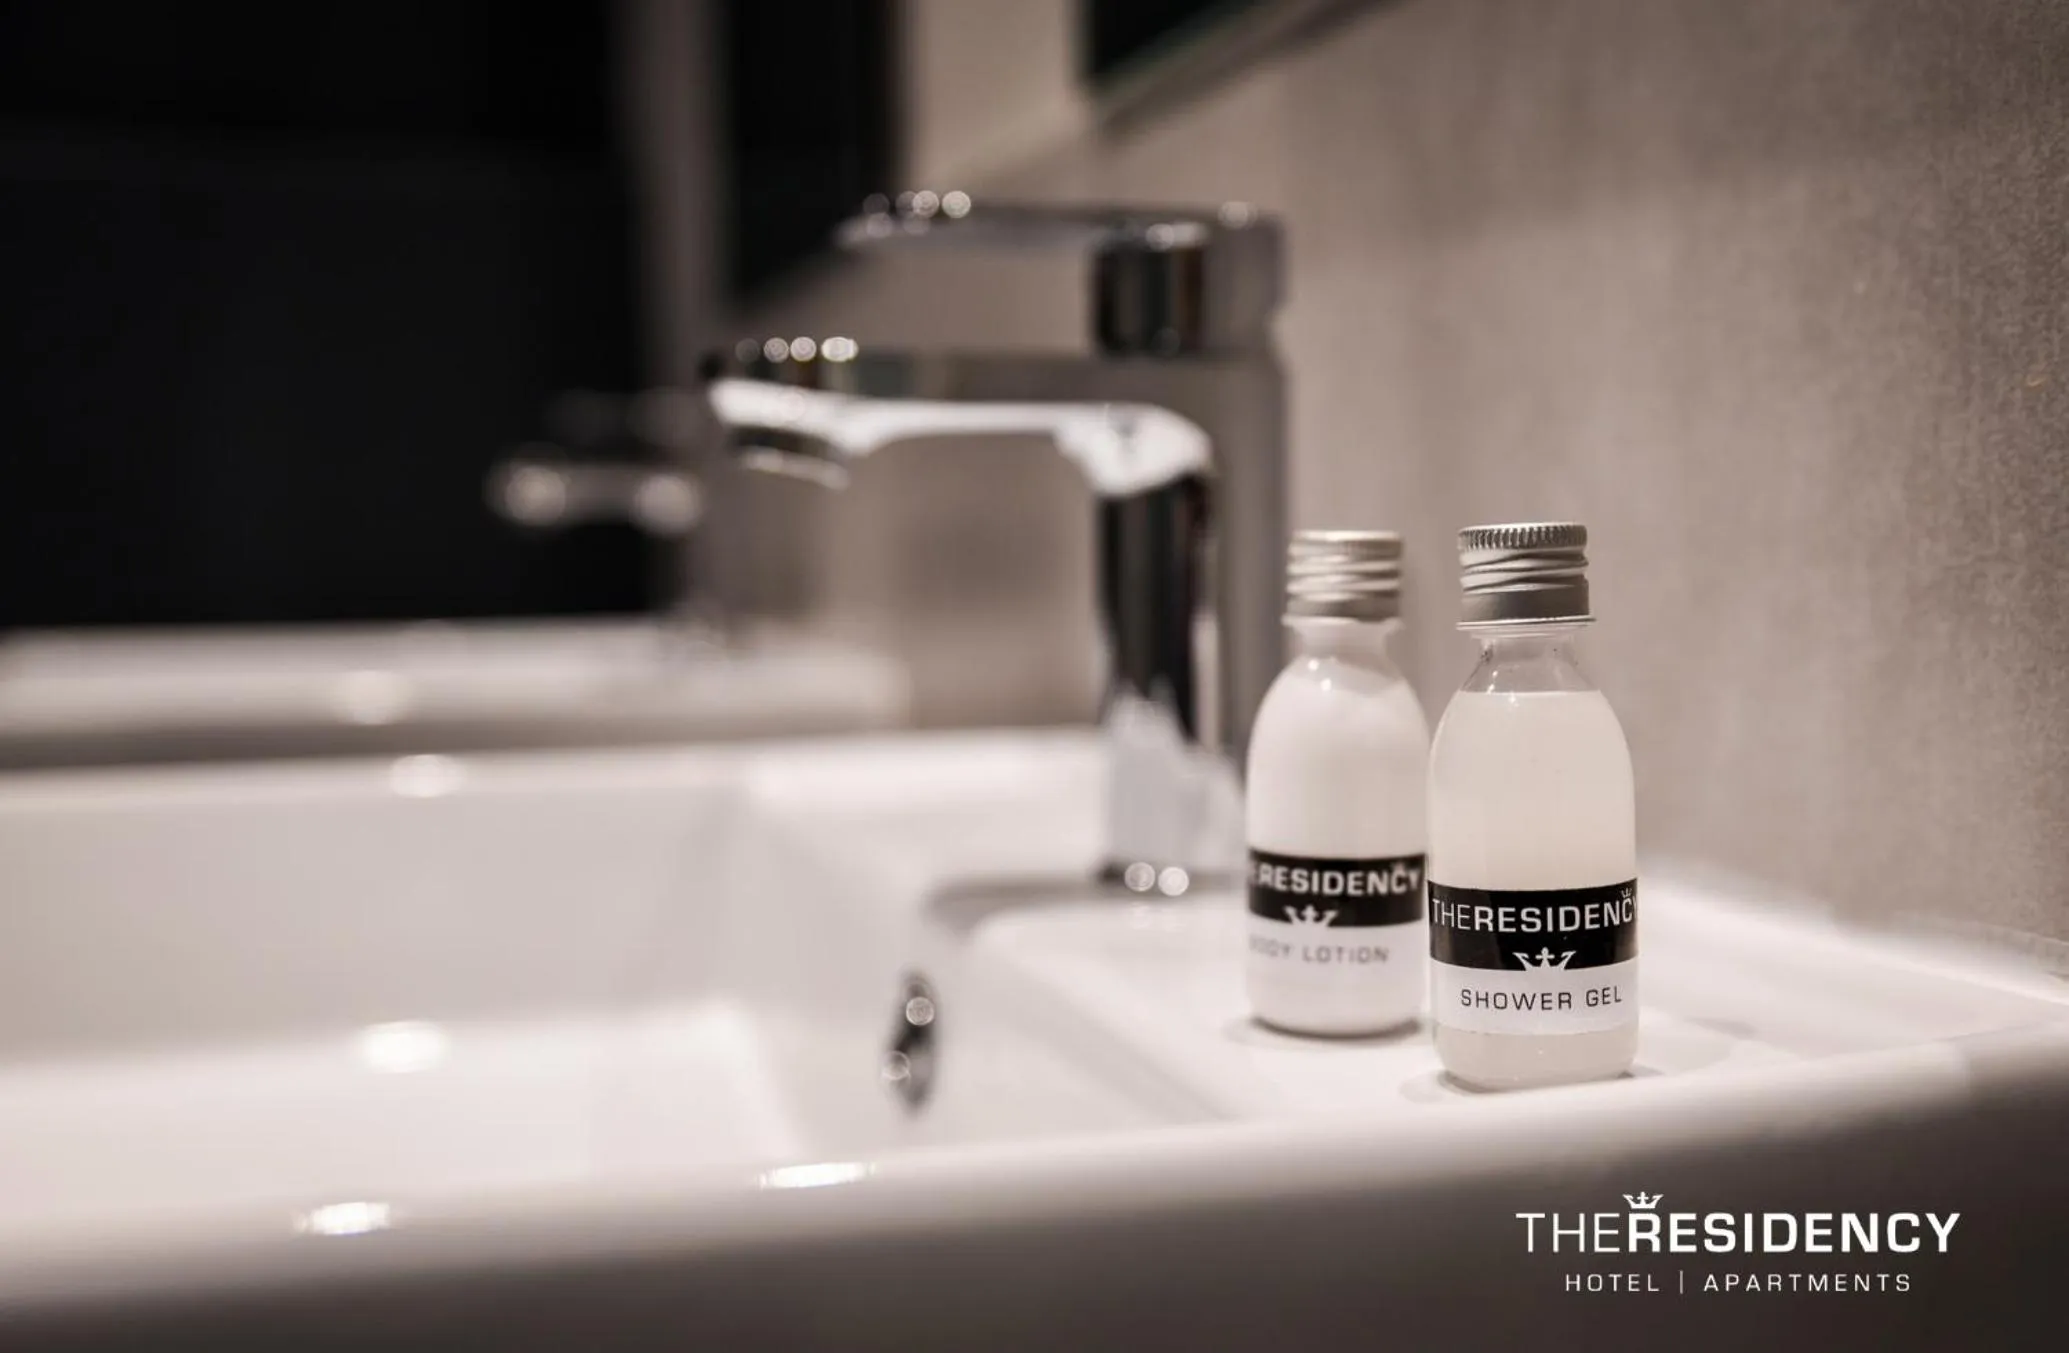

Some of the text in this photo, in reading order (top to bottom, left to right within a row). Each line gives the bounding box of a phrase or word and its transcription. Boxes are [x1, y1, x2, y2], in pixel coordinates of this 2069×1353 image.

[1302, 944, 1389, 964] LOTION
[1461, 986, 1622, 1011] SHOWER GEL
